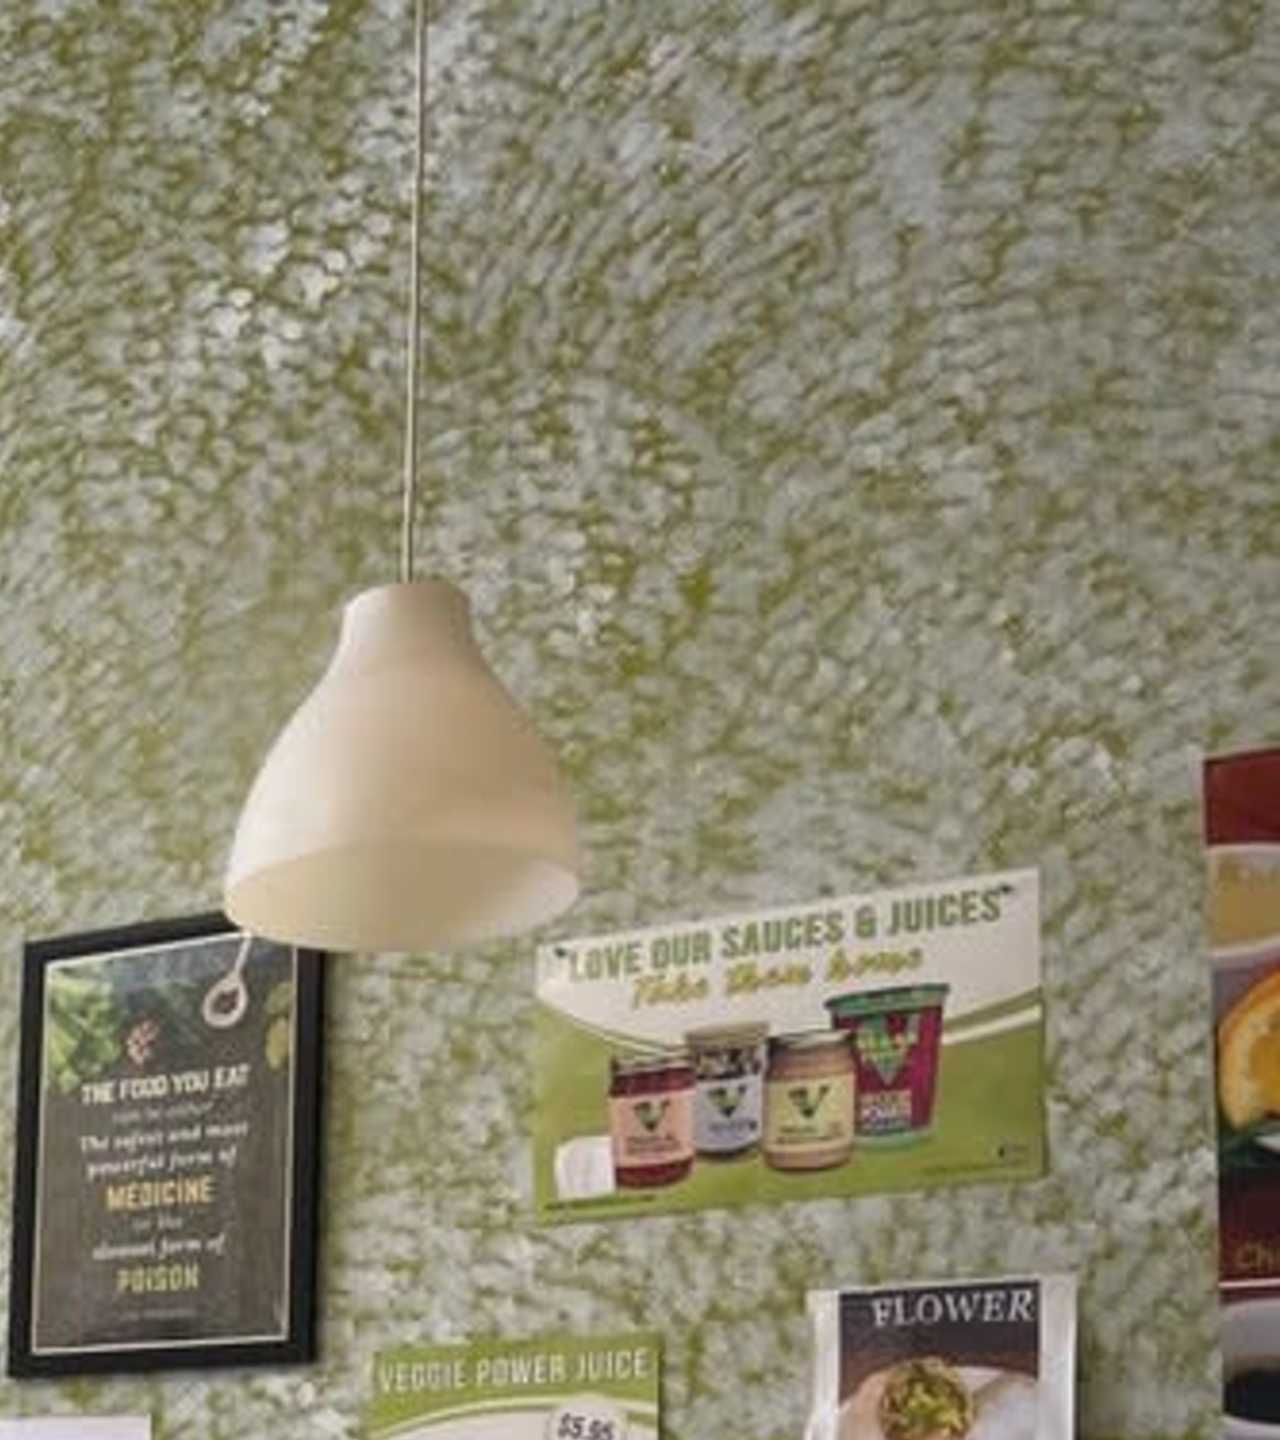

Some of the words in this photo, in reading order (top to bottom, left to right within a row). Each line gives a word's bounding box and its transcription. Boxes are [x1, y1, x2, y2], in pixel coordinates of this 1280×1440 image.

[650, 931, 712, 970] OUR
[720, 908, 844, 958] SAUCES
[855, 904, 877, 939] &
[886, 889, 1002, 937] JUICES
[81, 1080, 115, 1104] THE
[119, 1073, 169, 1100] FOOD
[170, 1068, 210, 1095] YOU
[214, 1063, 251, 1089] EAT
[167, 1123, 202, 1142] and
[104, 1173, 216, 1213] MEDICINE
[117, 1262, 199, 1296] POISON
[873, 1288, 1036, 1328] FLOWER
[380, 1359, 467, 1392] VEGGIE
[476, 1354, 566, 1386] POWER
[575, 1348, 648, 1379] JUICE
